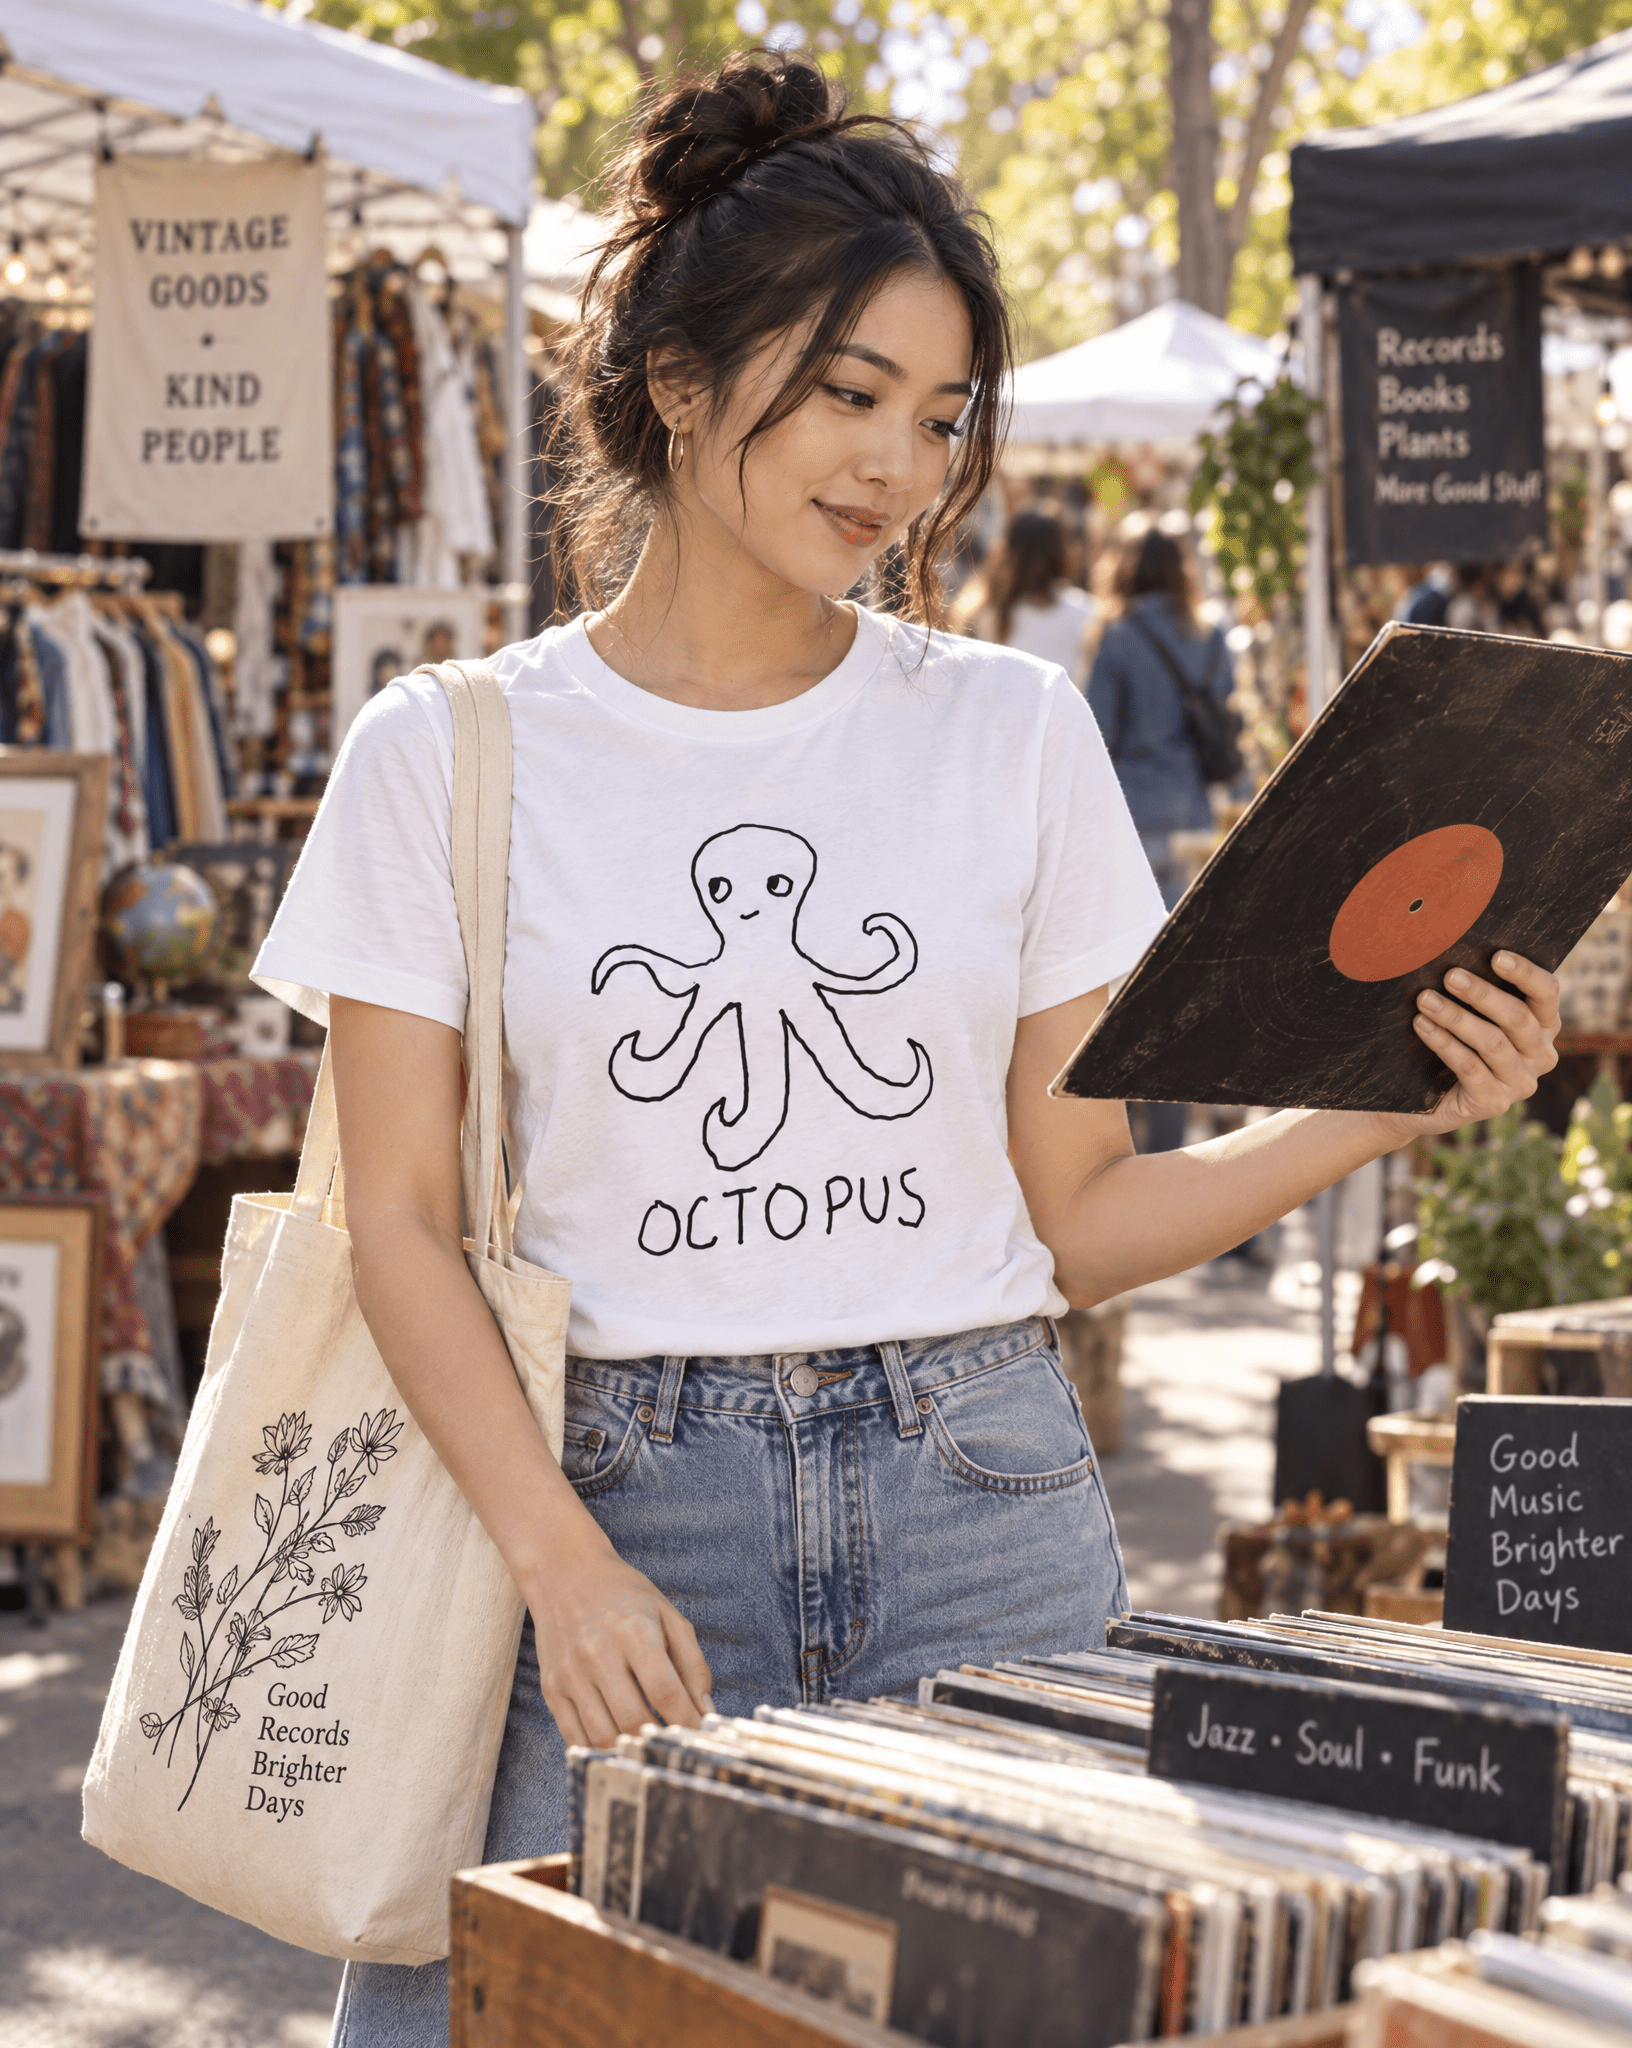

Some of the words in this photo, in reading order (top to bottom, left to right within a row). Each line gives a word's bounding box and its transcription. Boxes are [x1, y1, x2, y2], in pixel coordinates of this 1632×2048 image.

[129, 215, 289, 254] VINTAGE
[150, 272, 269, 309] GOODS
[1377, 322, 1505, 367] Records
[165, 371, 261, 408] KIND
[1378, 372, 1471, 414] Books
[141, 427, 280, 463] PEOPLE
[1378, 420, 1471, 460] Plants
[1375, 472, 1430, 505] More
[1432, 471, 1490, 505] Good
[638, 1167, 926, 1256] OCTOPUS
[1490, 1431, 1579, 1473] Good
[1490, 1483, 1583, 1519] Music
[1491, 1527, 1624, 1575] Brighter
[1496, 1578, 1579, 1624] Days
[267, 1682, 328, 1709] Good
[257, 1716, 350, 1746] Records
[1187, 1702, 1257, 1755] Jazz
[1296, 1720, 1364, 1771] Soul
[1415, 1736, 1504, 1796] Funk
[251, 1750, 347, 1787] Brighter
[245, 1785, 305, 1823] Days
